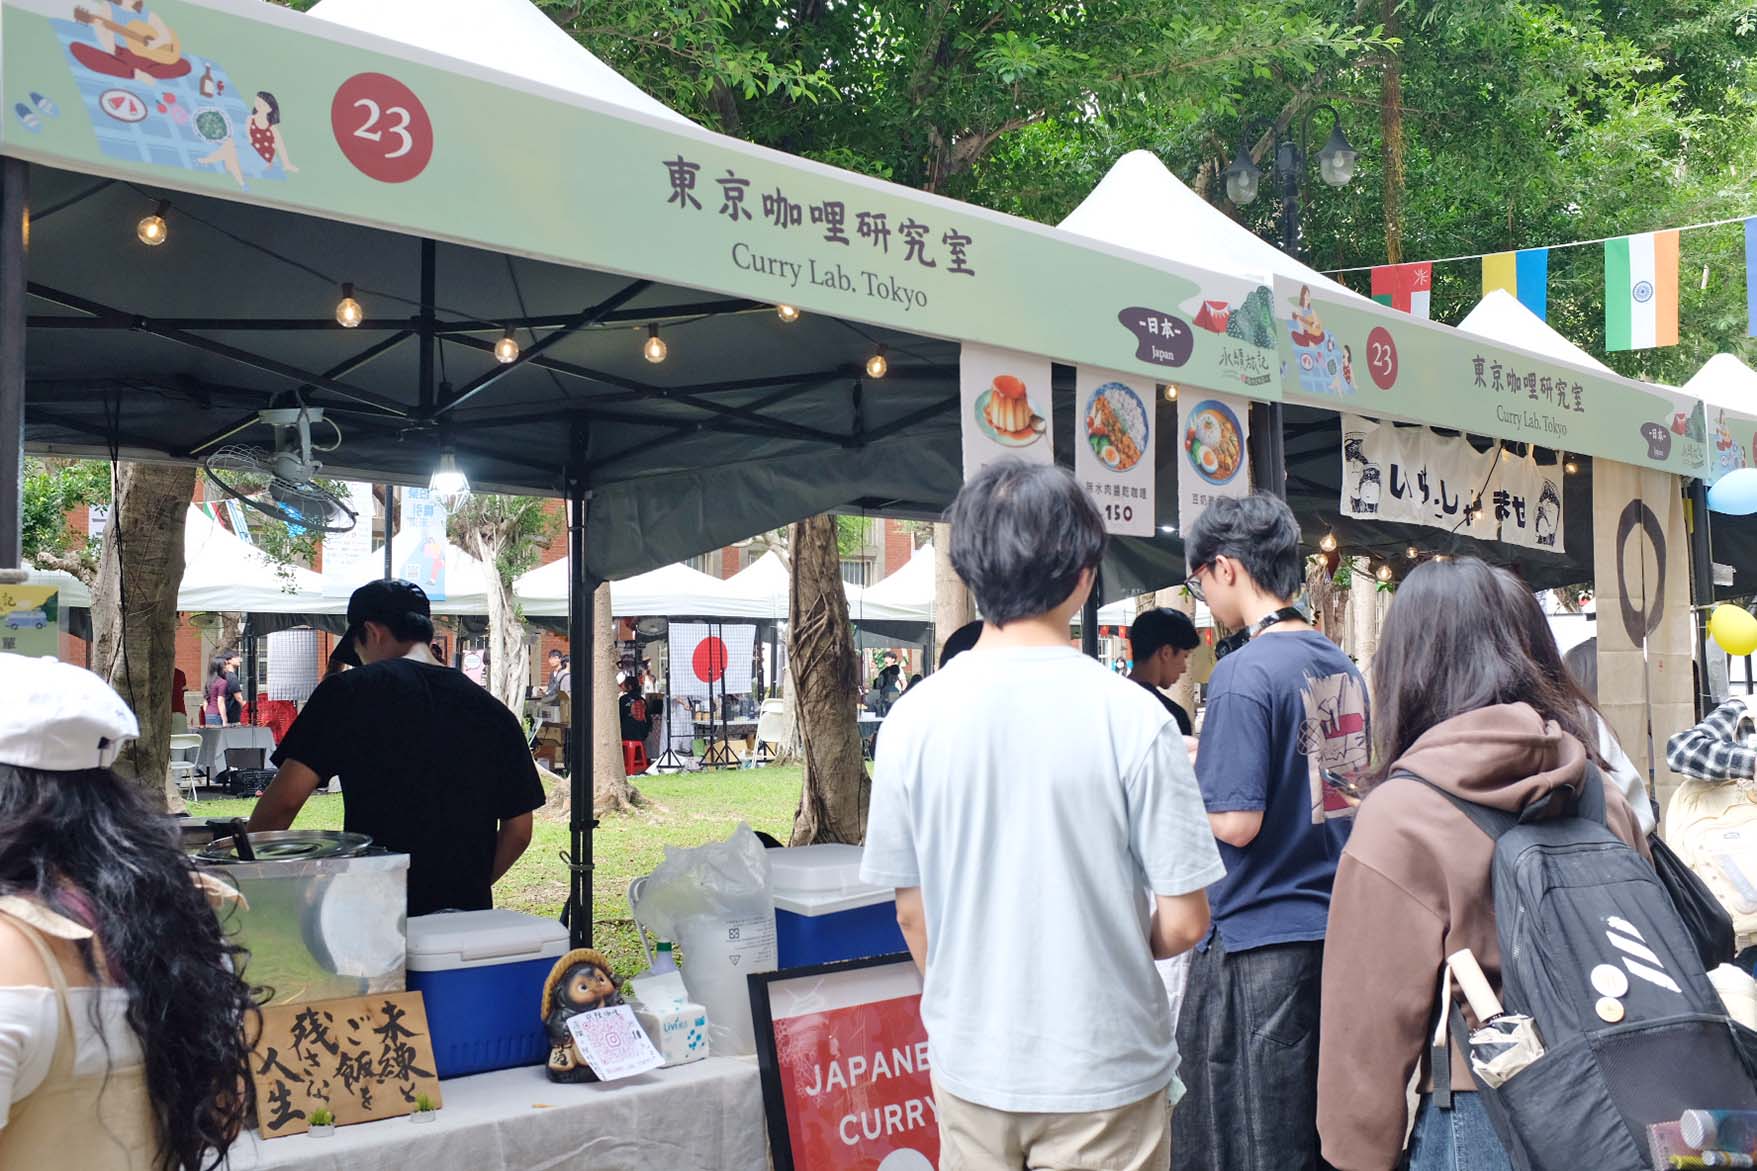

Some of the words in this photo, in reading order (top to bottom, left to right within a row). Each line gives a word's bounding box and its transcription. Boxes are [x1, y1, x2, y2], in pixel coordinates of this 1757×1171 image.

[353, 98, 413, 158] 23
[663, 155, 976, 277] 東京咖哩研究室
[732, 242, 802, 288] Curry
[809, 258, 857, 294] Lab.
[861, 271, 928, 312] Tokyo
[1151, 345, 1175, 362] Japan
[1372, 341, 1393, 376] 23
[1472, 354, 1585, 413] 東京咖哩研究室
[1496, 404, 1522, 428] Curry
[1523, 414, 1542, 431] Lab.
[1542, 414, 1568, 438] Tokyo
[1105, 503, 1133, 522] 150
[256, 1047, 306, 1131] 人生
